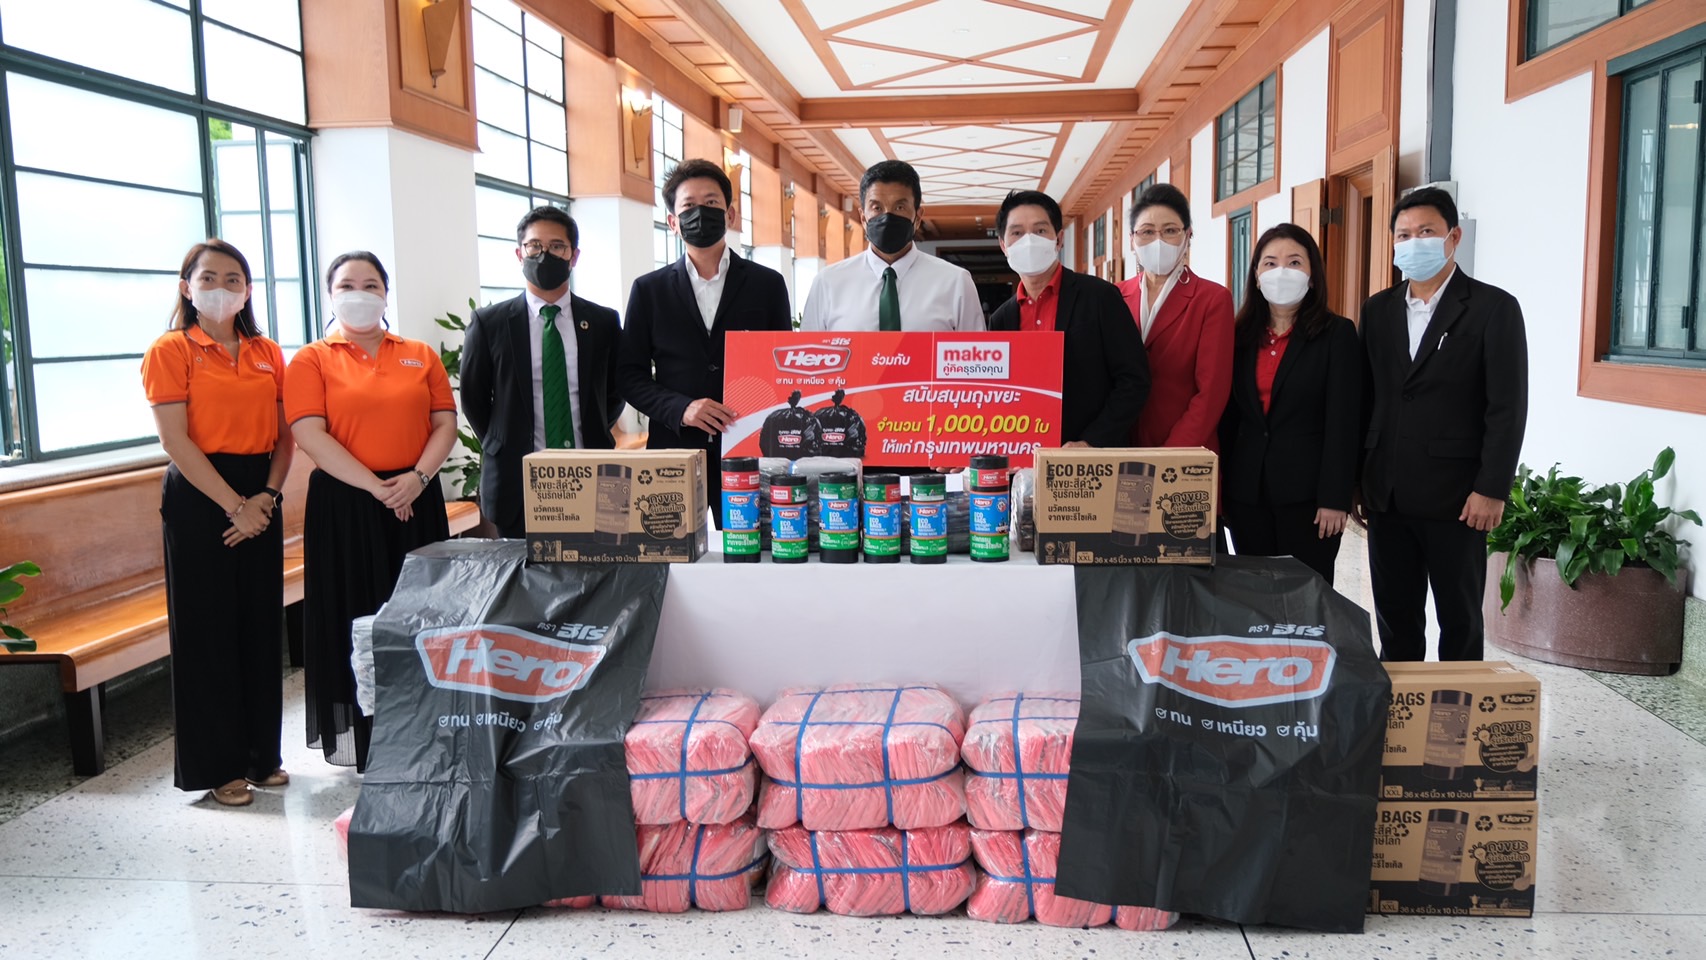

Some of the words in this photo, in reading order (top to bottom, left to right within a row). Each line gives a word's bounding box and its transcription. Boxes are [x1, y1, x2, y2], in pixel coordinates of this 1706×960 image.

[784, 351, 841, 367] Hero
[872, 352, 911, 366] ร่วมกับ
[943, 346, 1003, 361] makro
[943, 363, 1003, 376] คู่คิดธุรกิจคุณ
[803, 376, 825, 384] เหนียว
[903, 385, 1021, 409] สนับสนุนถุงขยะ
[877, 416, 922, 432] จำนวน
[926, 414, 1030, 437] 1,000,000
[1034, 418, 1050, 433] ใบ
[881, 438, 913, 454] ให้แก่
[913, 440, 1042, 460] กรุงเทพมหานคร
[530, 466, 555, 478] ECO
[558, 466, 592, 478] BAGS
[1047, 464, 1073, 476] ECO
[1077, 464, 1113, 476] BAGS
[533, 504, 564, 512] นวัตกรรม
[1048, 504, 1080, 512] นวัตกรรม
[534, 512, 580, 521] จากขยะรีไซเคิล
[1048, 512, 1097, 521] จากขยะรีไซเคิล
[537, 622, 557, 632] ตรา
[557, 622, 609, 640] ฮีโร่
[1248, 624, 1270, 634] ตรา
[445, 637, 584, 688] Hero
[1160, 644, 1313, 687] Hero
[1505, 695, 1533, 703] Hero
[450, 714, 470, 727] ทน
[484, 711, 527, 734] เหนียว
[1170, 710, 1192, 726] ทน
[1216, 719, 1268, 738] เหนียว
[1294, 720, 1318, 742] คุ้ม
[1382, 810, 1422, 823] BAGS
[1502, 815, 1530, 823] Hero
